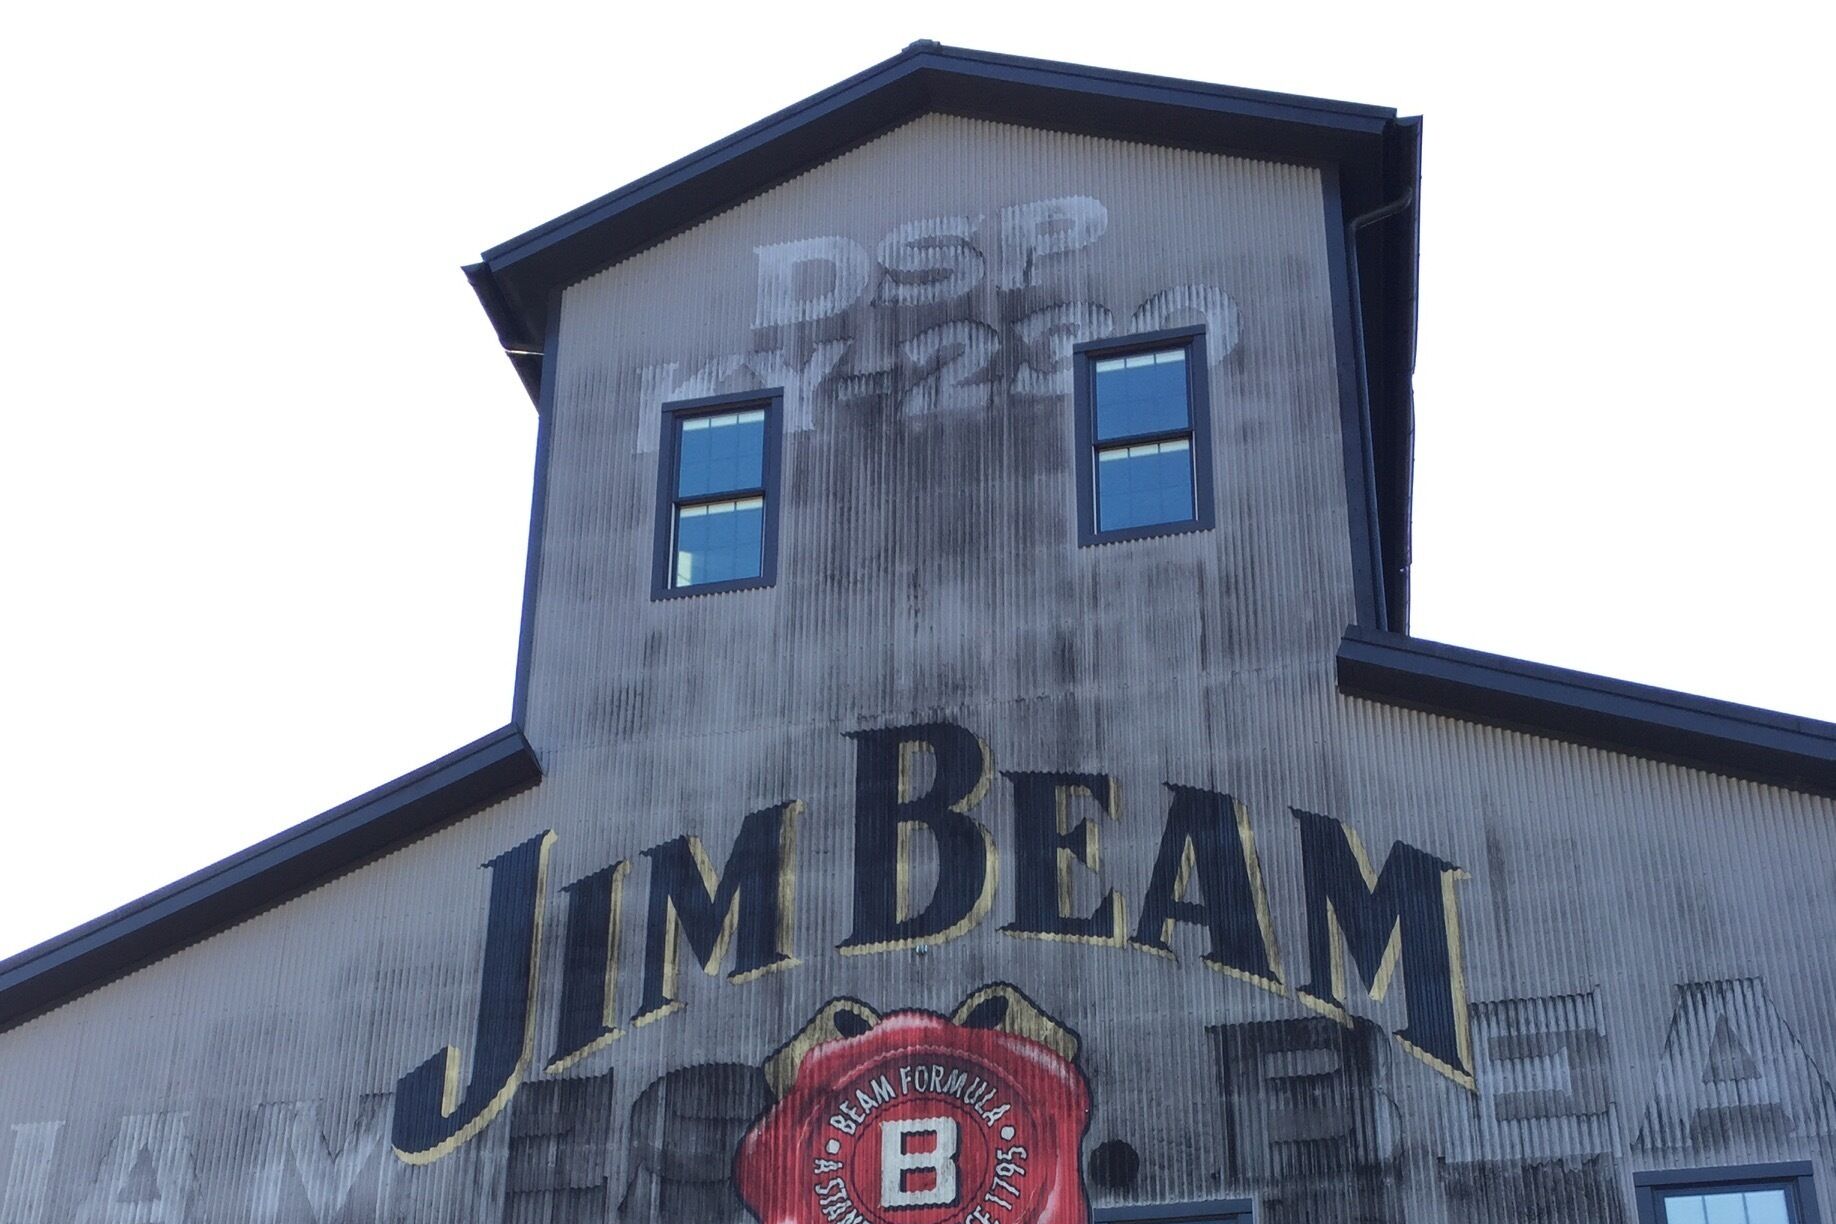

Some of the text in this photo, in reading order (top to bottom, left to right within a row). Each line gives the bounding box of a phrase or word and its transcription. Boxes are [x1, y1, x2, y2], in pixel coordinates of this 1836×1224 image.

[750, 195, 1108, 330] DSP
[391, 721, 1479, 1166] JIM BEAM
[829, 1064, 1012, 1136] BEAM FORMULA
[813, 1158, 843, 1175] A
[984, 1145, 1028, 1211] 1795
[878, 1115, 960, 1210] B
